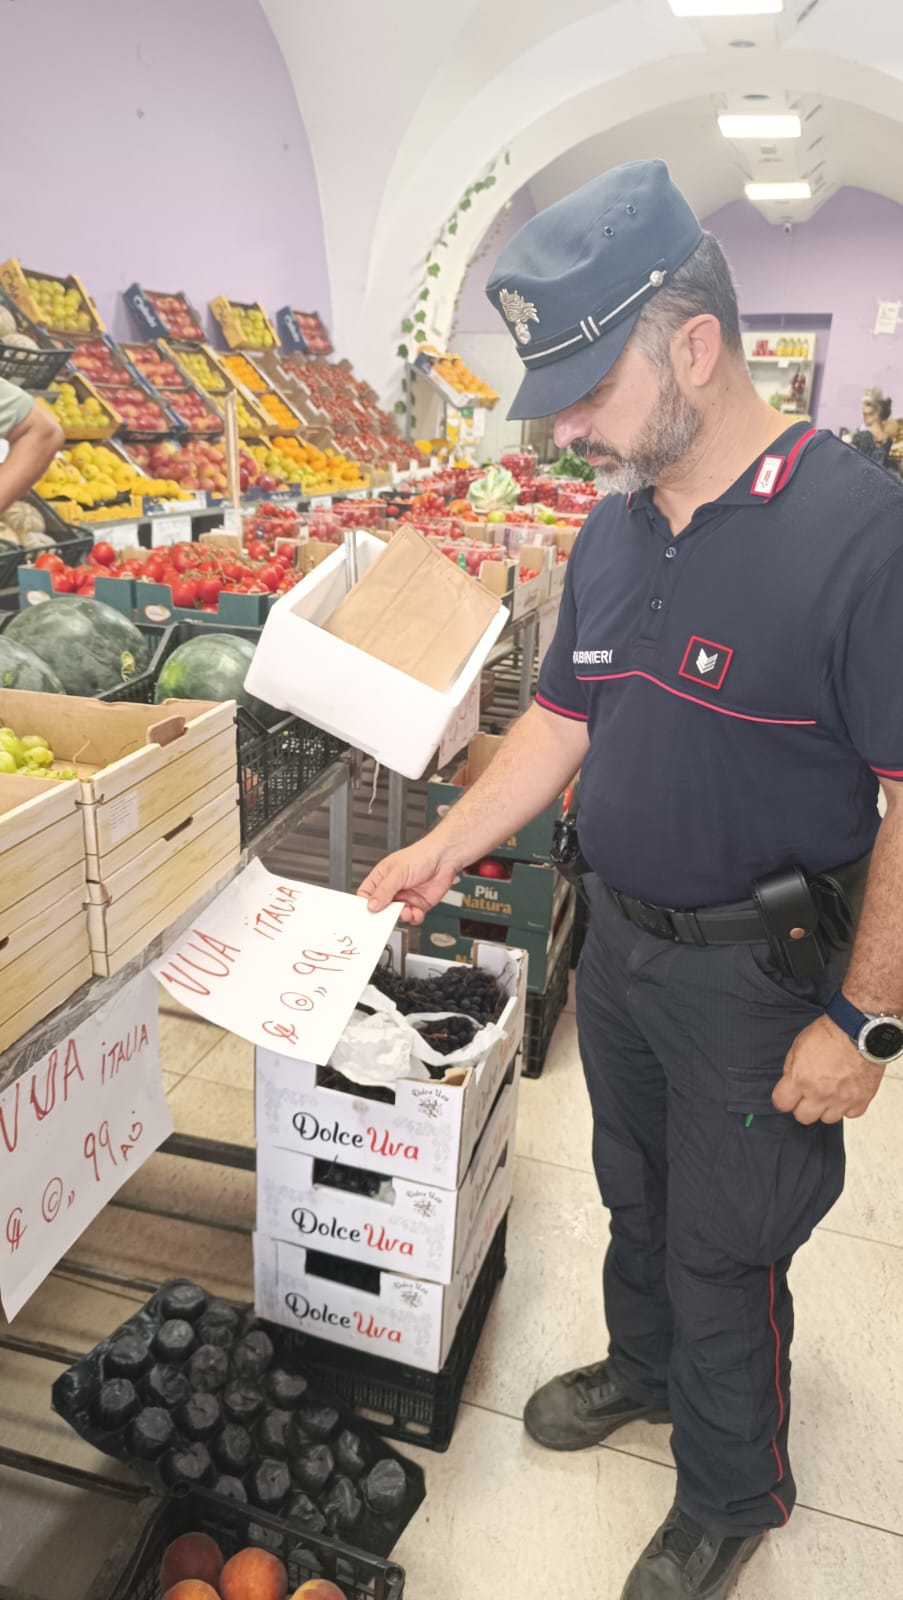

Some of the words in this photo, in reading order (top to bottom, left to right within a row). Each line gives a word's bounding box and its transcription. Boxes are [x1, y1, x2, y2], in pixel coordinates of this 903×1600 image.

[462, 894, 513, 916] Natura
[292, 1111, 364, 1149] Dolce
[366, 1126, 420, 1161] Uva
[291, 1207, 361, 1243] Dolce
[363, 1223, 414, 1257] Uva
[284, 1291, 351, 1329] Dolce
[352, 1311, 403, 1344] Uva
